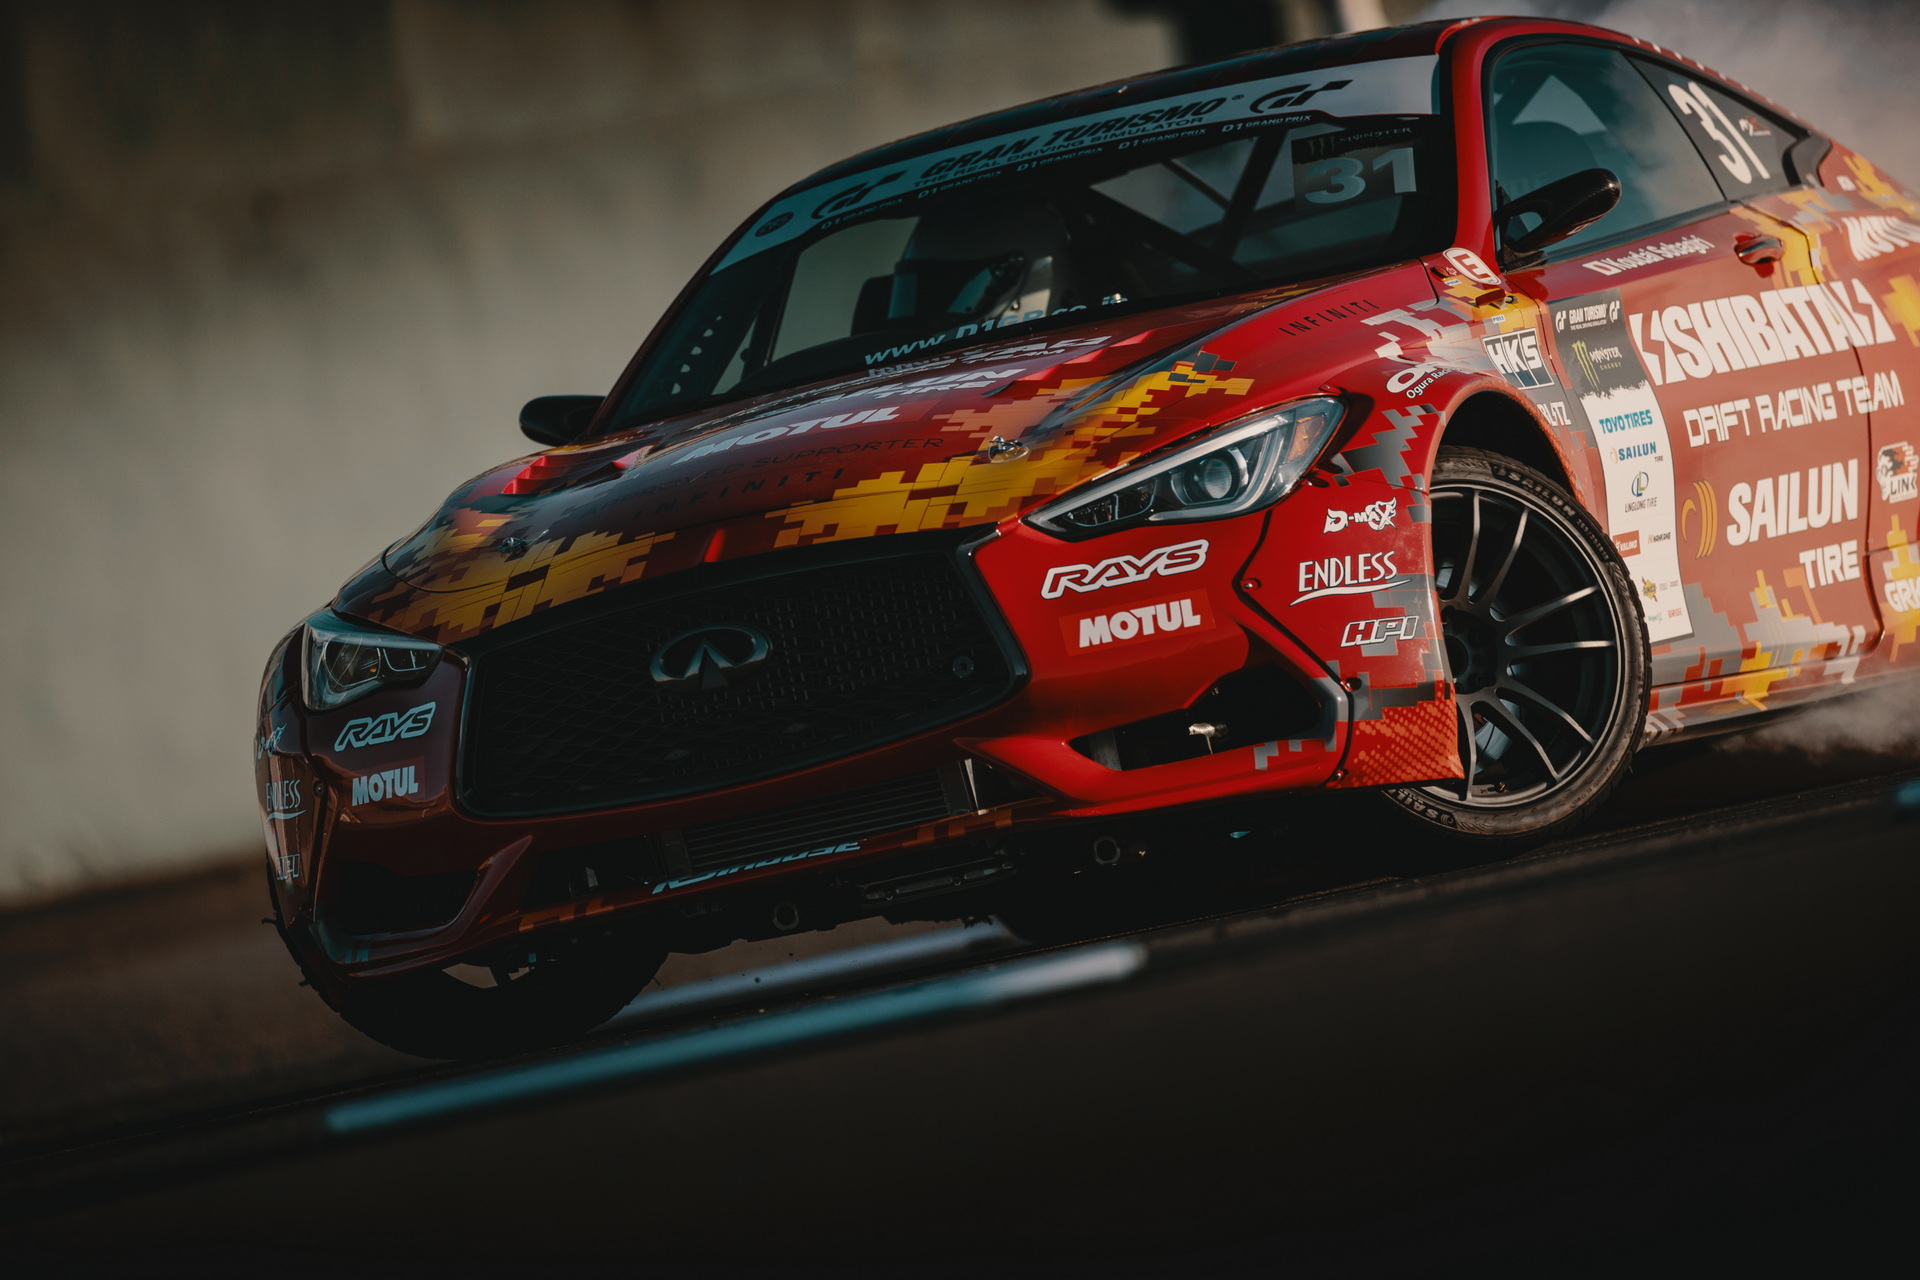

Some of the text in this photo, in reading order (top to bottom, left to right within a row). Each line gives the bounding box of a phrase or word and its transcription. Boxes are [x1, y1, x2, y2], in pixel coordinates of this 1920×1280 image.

[920, 97, 1228, 179] GRAN TURISMO
[1118, 138, 1140, 150] D1
[1181, 127, 1208, 138] PRIX
[1220, 121, 1244, 133] D1
[1285, 114, 1312, 123] PRIX
[1668, 81, 1771, 185] 31
[913, 116, 1204, 188] THE REAL DRIVING SIMULATOR
[1016, 160, 1038, 173] D1
[1077, 146, 1103, 157] PRIX
[917, 187, 940, 199] D1
[1305, 147, 1417, 204] 31
[1453, 253, 1492, 280] E
[1278, 299, 1381, 336] INFINITI
[1569, 307, 1584, 325] GRAN
[1660, 283, 1868, 378] SHIBATA
[1487, 335, 1542, 375] HKS
[1589, 346, 1623, 364] MONSTER
[1406, 376, 1435, 399] Ogura
[1683, 370, 1905, 447] DRIFT RACING TEAM
[671, 405, 900, 465] MOTUL
[752, 438, 945, 468] SUPPORTER
[1618, 441, 1657, 461] SAILUN
[1654, 455, 1664, 463] TIRE
[633, 468, 845, 521] INFINITI
[1726, 458, 1858, 546] SAILUN
[1040, 539, 1210, 599] RAYS
[1298, 551, 1398, 592] ENDLESS
[1799, 539, 1860, 589] TIRE
[1079, 598, 1201, 648] MOTUL
[334, 701, 436, 752] RAYS
[266, 779, 301, 812] ENDLESS
[352, 765, 419, 807] MOTUL
